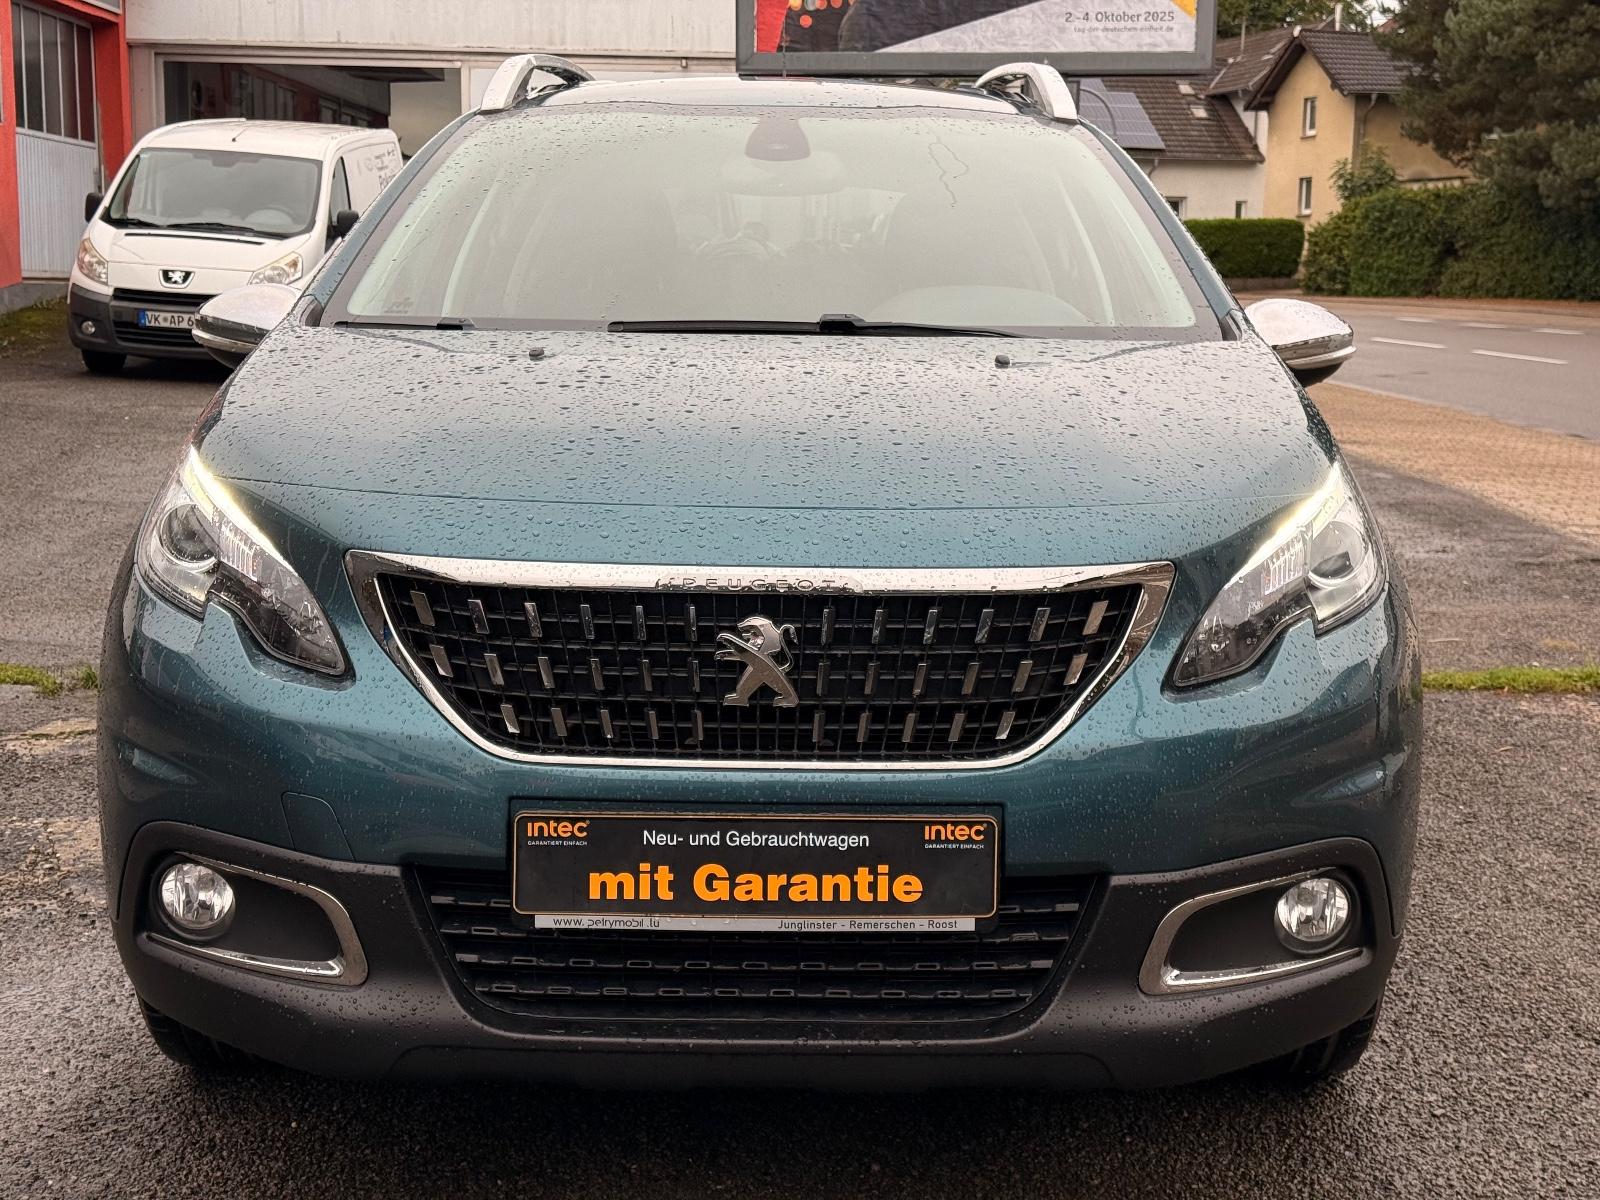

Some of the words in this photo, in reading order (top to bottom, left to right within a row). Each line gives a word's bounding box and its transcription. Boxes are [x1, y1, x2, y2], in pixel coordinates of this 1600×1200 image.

[1095, 11, 1142, 23] Oktober
[1144, 11, 1175, 23] 2025
[145, 313, 161, 326] VK
[170, 314, 184, 327] AP
[682, 578, 836, 592] PEUGEOT
[527, 820, 588, 838] intec
[924, 823, 985, 841] intec
[643, 830, 684, 846] Neu-
[689, 831, 720, 846] und
[726, 831, 870, 850] Gebrauchtwagen
[589, 863, 674, 900] mit
[693, 863, 924, 903] Garantie
[778, 920, 837, 931] Junglinster
[849, 920, 916, 930] Remerschen
[927, 920, 958, 930] Roost
